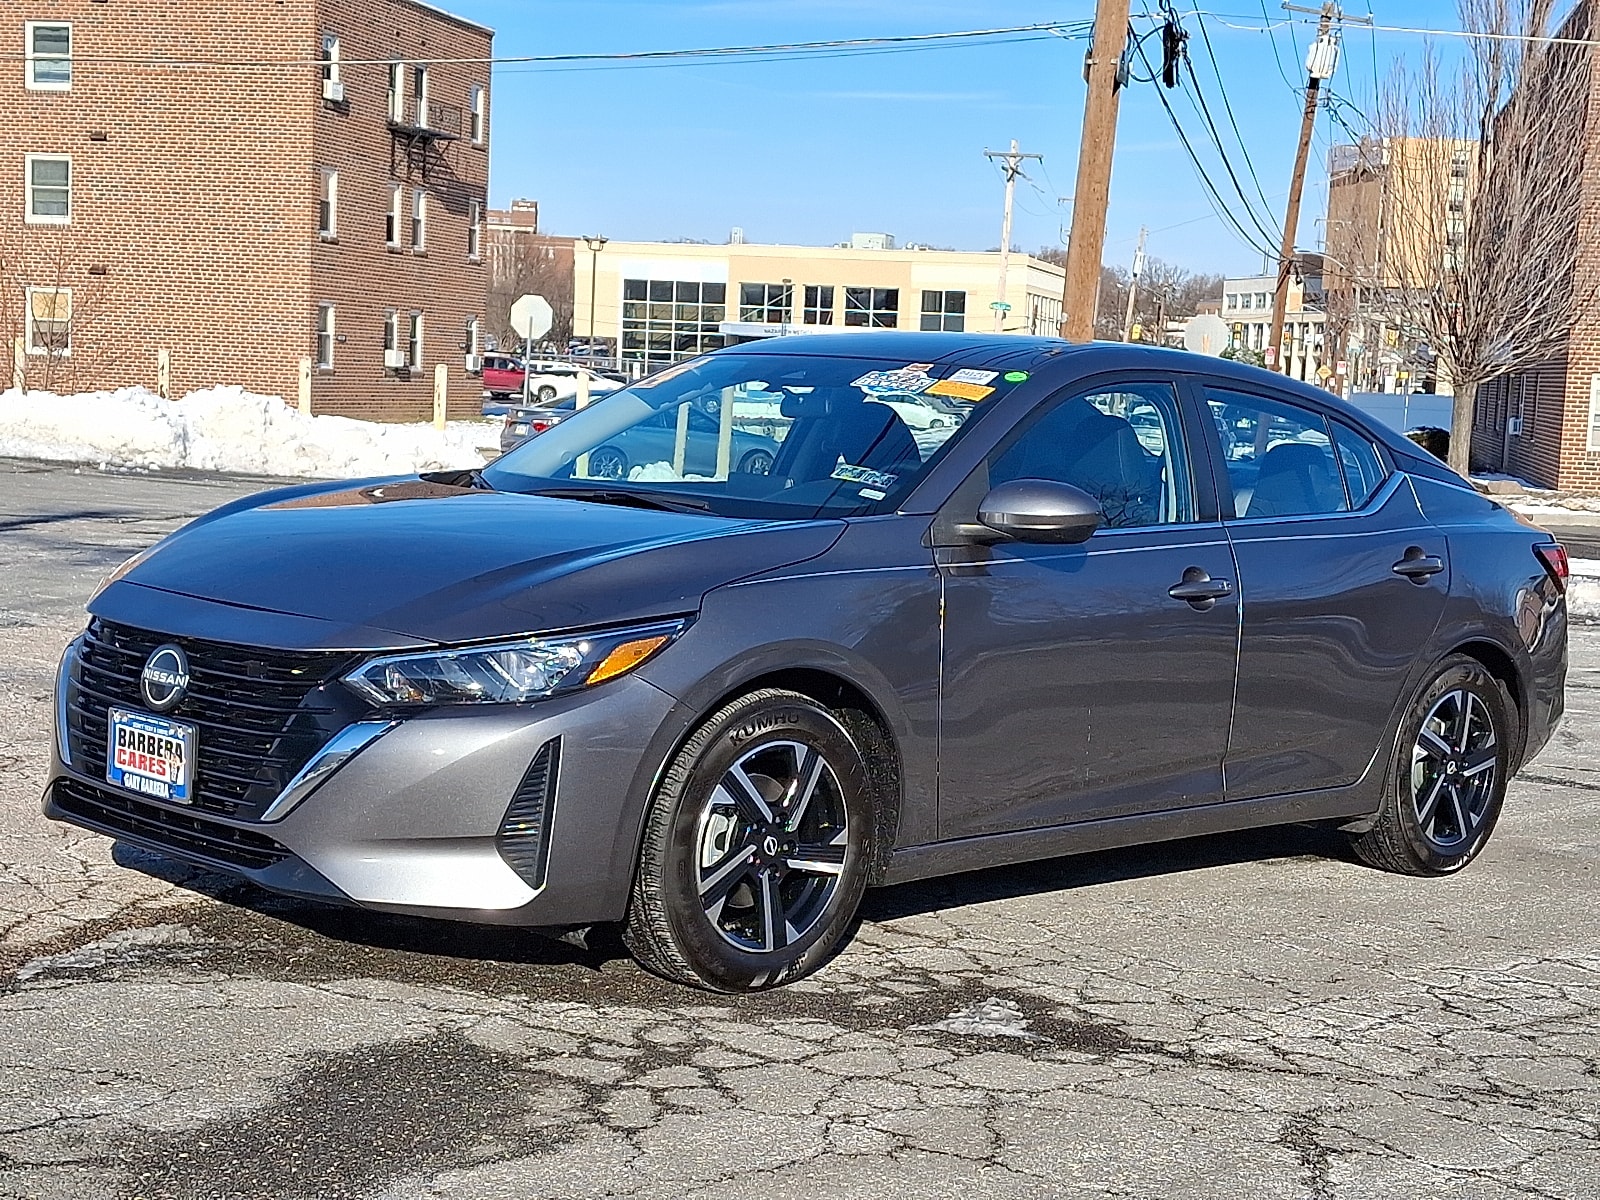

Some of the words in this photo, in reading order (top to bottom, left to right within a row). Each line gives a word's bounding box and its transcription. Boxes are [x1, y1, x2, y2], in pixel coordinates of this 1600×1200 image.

[143, 668, 189, 688] NISSAN
[118, 727, 183, 762] BARBERA
[729, 713, 799, 747] KUMHO
[117, 749, 167, 777] CARES
